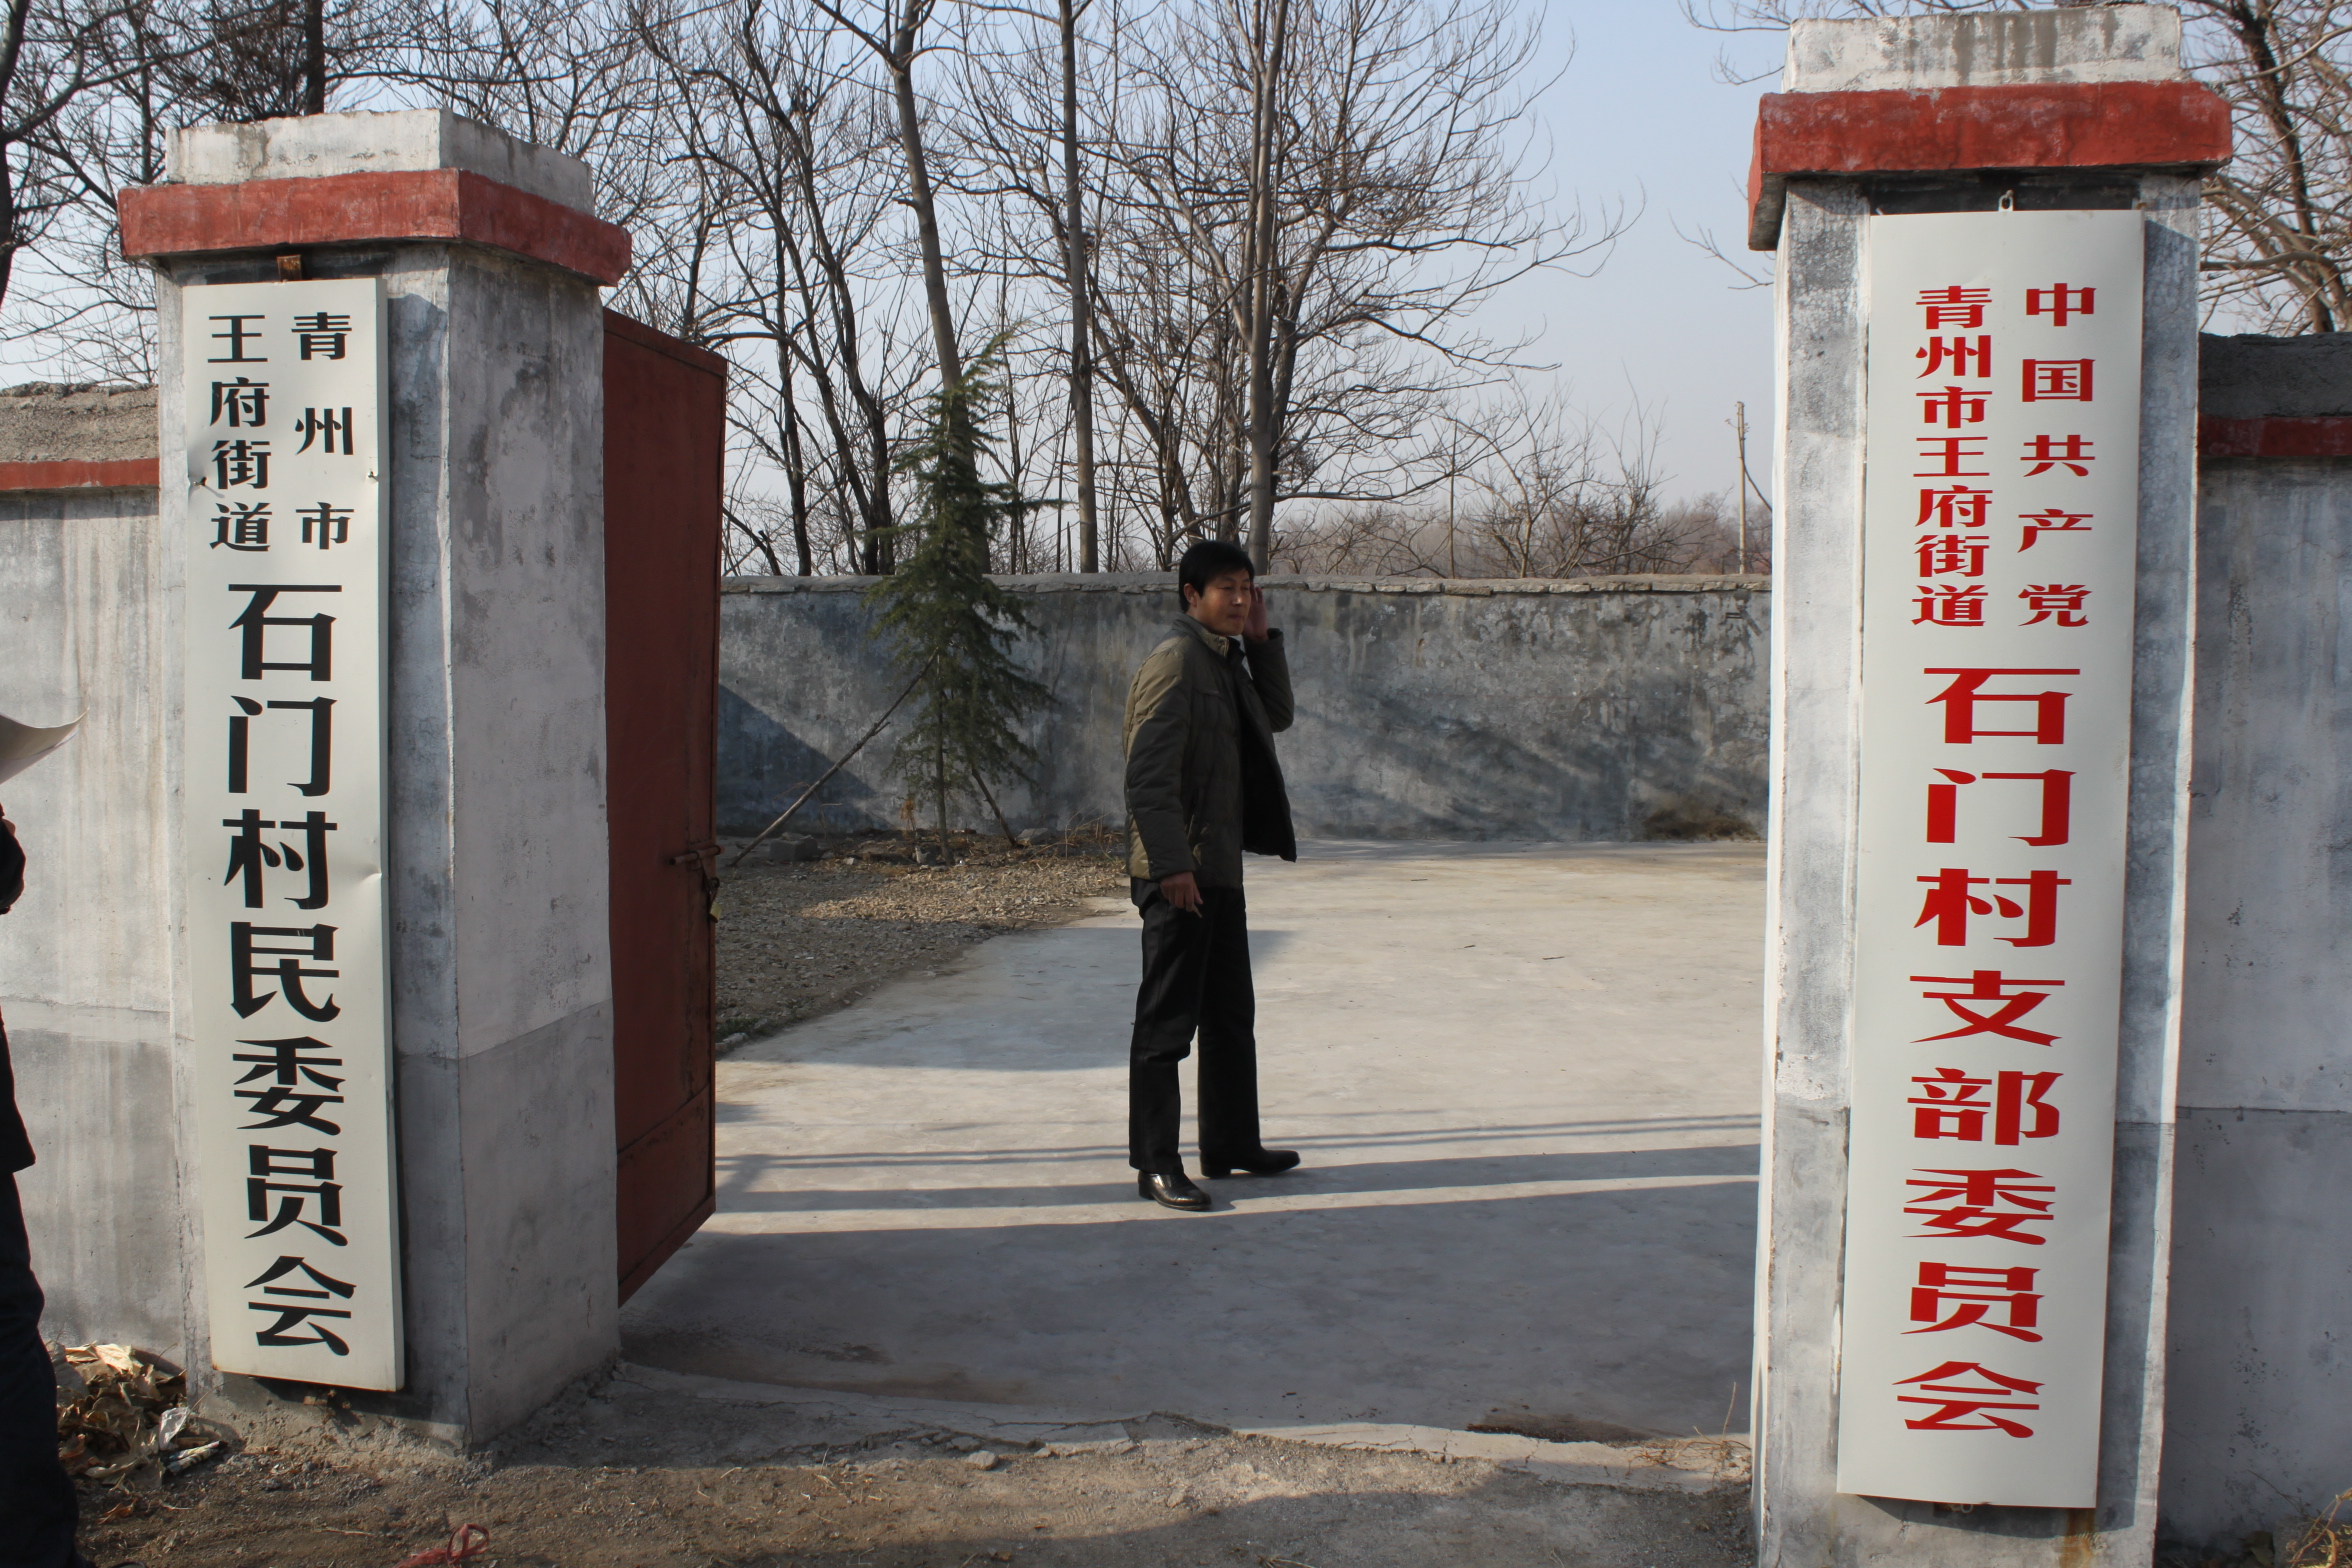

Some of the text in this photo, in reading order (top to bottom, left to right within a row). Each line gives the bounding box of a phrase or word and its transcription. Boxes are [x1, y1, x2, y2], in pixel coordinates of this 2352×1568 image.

[208, 314, 272, 552] 王府街道
[291, 312, 354, 550] 青州市
[1911, 285, 1993, 628] 青州市王府街道
[2018, 282, 2096, 628] 中国共产党
[222, 584, 357, 1356] 石门村民委员会
[1892, 668, 2081, 1438] 石门村支部委员会
